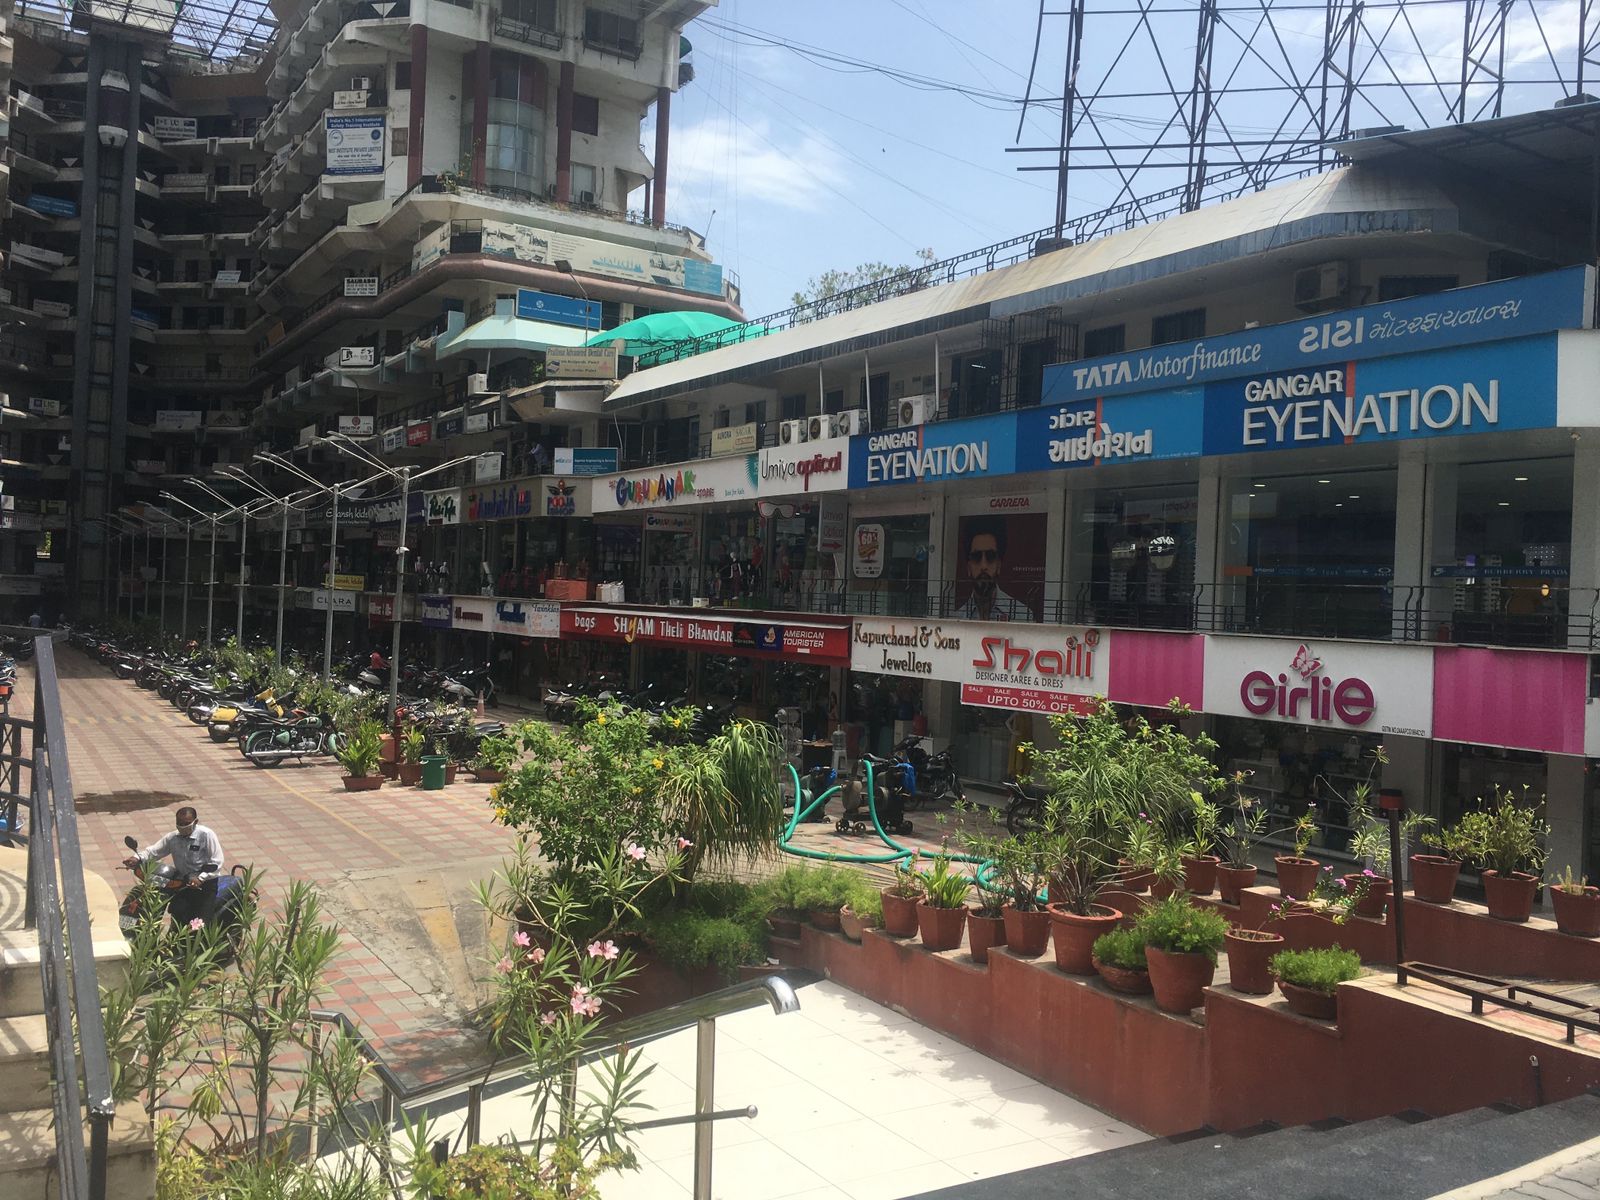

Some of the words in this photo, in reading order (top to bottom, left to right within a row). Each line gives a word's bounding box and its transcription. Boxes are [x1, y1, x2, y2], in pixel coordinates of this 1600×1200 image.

[1073, 360, 1132, 391] TATA
[1134, 342, 1262, 382] Motorfinance
[1244, 369, 1344, 402] GANGAR
[1242, 380, 1499, 446] EYENATION
[868, 430, 918, 452] GANGAR
[761, 449, 797, 480] Umiya
[797, 451, 842, 492] optical
[866, 440, 988, 483] EYENATION
[989, 497, 1031, 509] CARRERA
[1540, 568, 1568, 576] PRADA
[574, 613, 596, 632] bags
[613, 616, 655, 643] SHYAM
[783, 629, 825, 640] AMERICAN
[783, 638, 824, 648] TOURISTER
[854, 622, 919, 648] Kapurchand
[919, 626, 933, 648] &
[934, 626, 961, 651] Sons
[880, 648, 933, 674] Jewellers
[972, 629, 1100, 679] Shaili
[968, 685, 983, 693] SALE
[993, 687, 1011, 695] SALE
[1020, 690, 1039, 698] SALE
[1049, 693, 1069, 701] SALE
[975, 671, 1009, 684] DESIGNER
[1010, 675, 1032, 686] SAREE
[1033, 679, 1039, 687] &
[1041, 679, 1064, 689] DRESS
[987, 695, 1019, 708] UPTO
[1022, 698, 1047, 710] 50%
[1050, 701, 1076, 713] OFF
[1240, 670, 1377, 726] Girlie
